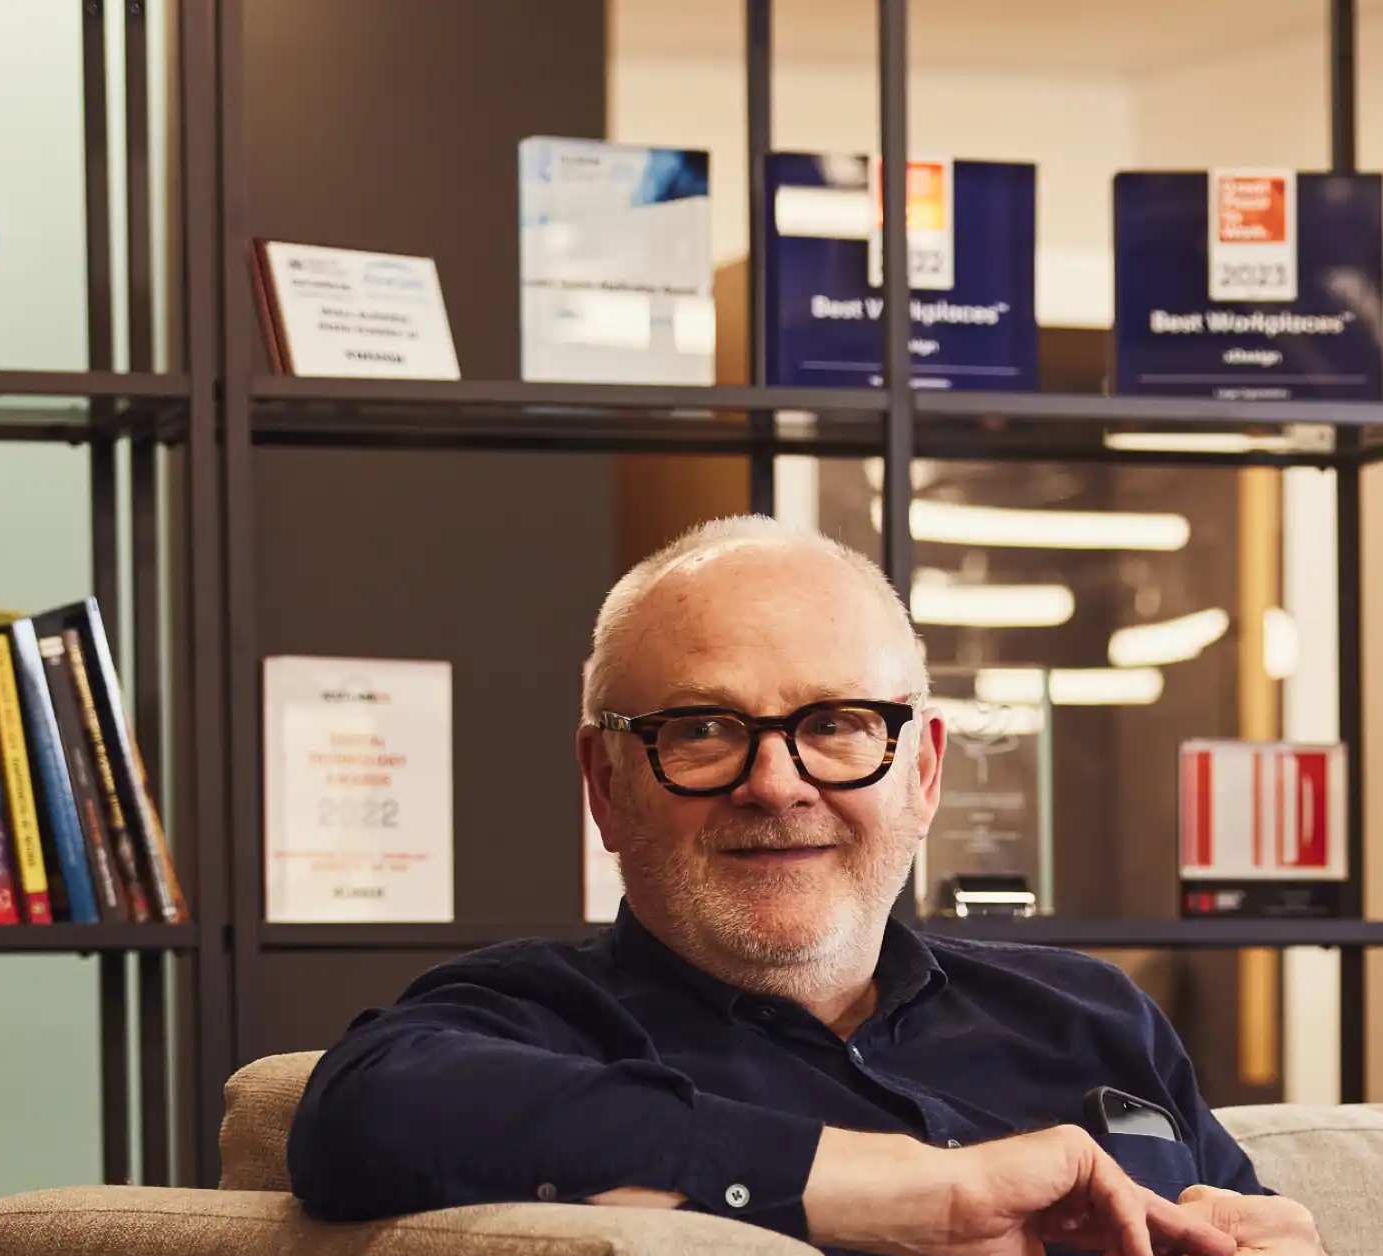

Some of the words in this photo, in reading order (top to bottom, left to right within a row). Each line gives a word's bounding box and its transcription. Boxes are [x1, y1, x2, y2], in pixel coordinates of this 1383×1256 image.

[1220, 263, 1287, 288] 2023
[810, 294, 864, 319] Best
[1150, 309, 1204, 334] Best
[317, 797, 400, 829] 2022
